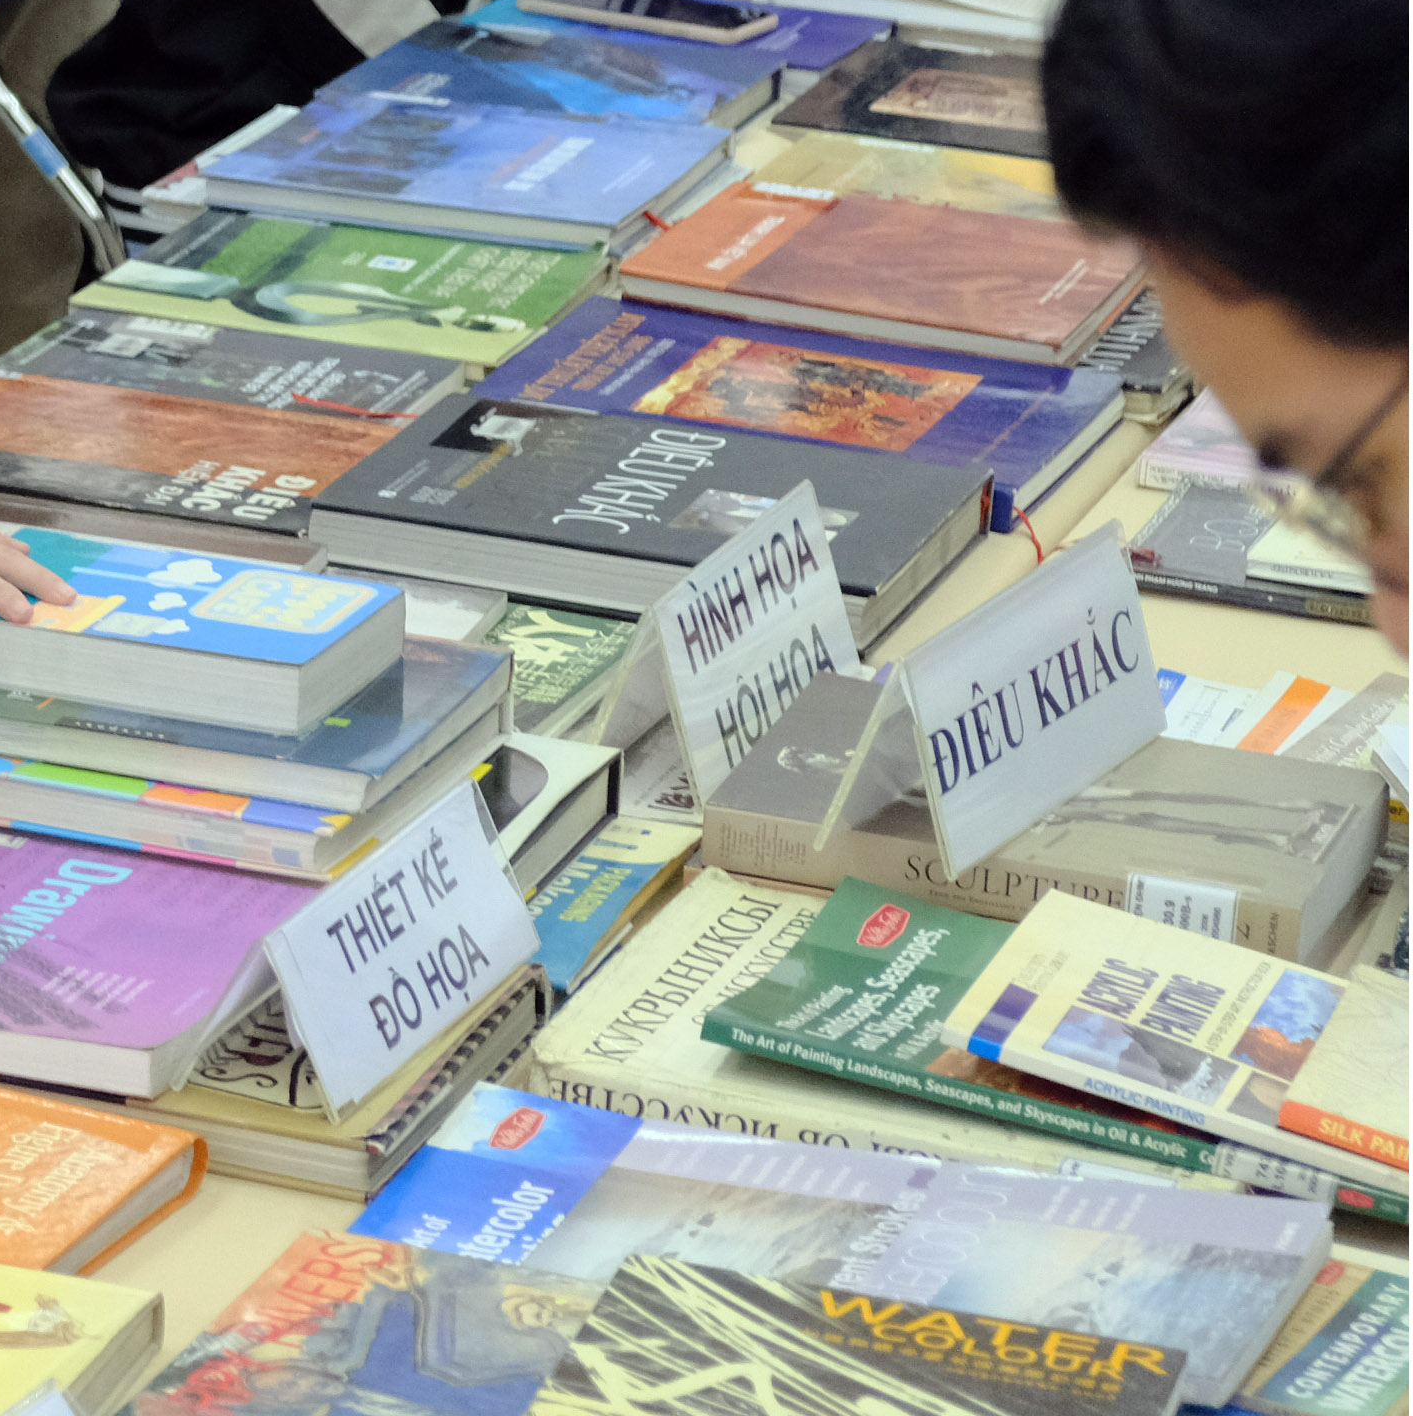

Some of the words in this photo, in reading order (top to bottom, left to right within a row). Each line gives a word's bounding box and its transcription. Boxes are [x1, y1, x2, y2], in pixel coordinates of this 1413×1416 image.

[676, 564, 754, 675] HÌNH
[754, 518, 820, 612] HỌA
[929, 684, 1026, 795] ĐIÊU
[1034, 604, 1140, 730] KHẮC
[327, 872, 413, 974] THIẾT
[411, 826, 459, 912] KẾ
[368, 963, 421, 1051] ĐỒ
[419, 926, 491, 1014] HỌA
[584, 893, 784, 1064] КУКРЫНИКСЫ
[865, 928, 951, 992] Seascapes,
[1076, 957, 1160, 1020] ACRYLIC
[1139, 973, 1226, 1043] PAINTING
[732, 1027, 754, 1047] The
[756, 1033, 776, 1051] Art
[777, 1041, 793, 1056] of
[794, 1044, 846, 1072] Painting
[847, 1058, 923, 1092] Landscapes,
[925, 1079, 995, 1109] Seascapes,
[997, 1097, 1022, 1115] and
[1024, 1104, 1091, 1134] Skyscapes
[1093, 1121, 1106, 1135] in
[1107, 1125, 1128, 1141] Oil
[1129, 1131, 1141, 1146] &
[1142, 1135, 1188, 1159] Acrylic
[1083, 1076, 1142, 1108] ACRYLIC
[1144, 1095, 1205, 1126] PAINTING
[1318, 1117, 1363, 1148] SILK
[10, 1120, 82, 1172] Figure
[434, 1214, 451, 1236] of
[459, 1179, 555, 1266] tercolor
[821, 1290, 1169, 1376] WATER
[872, 1322, 1125, 1381] COLOUR
[1286, 1282, 1409, 1399] CONTEMPORARY
